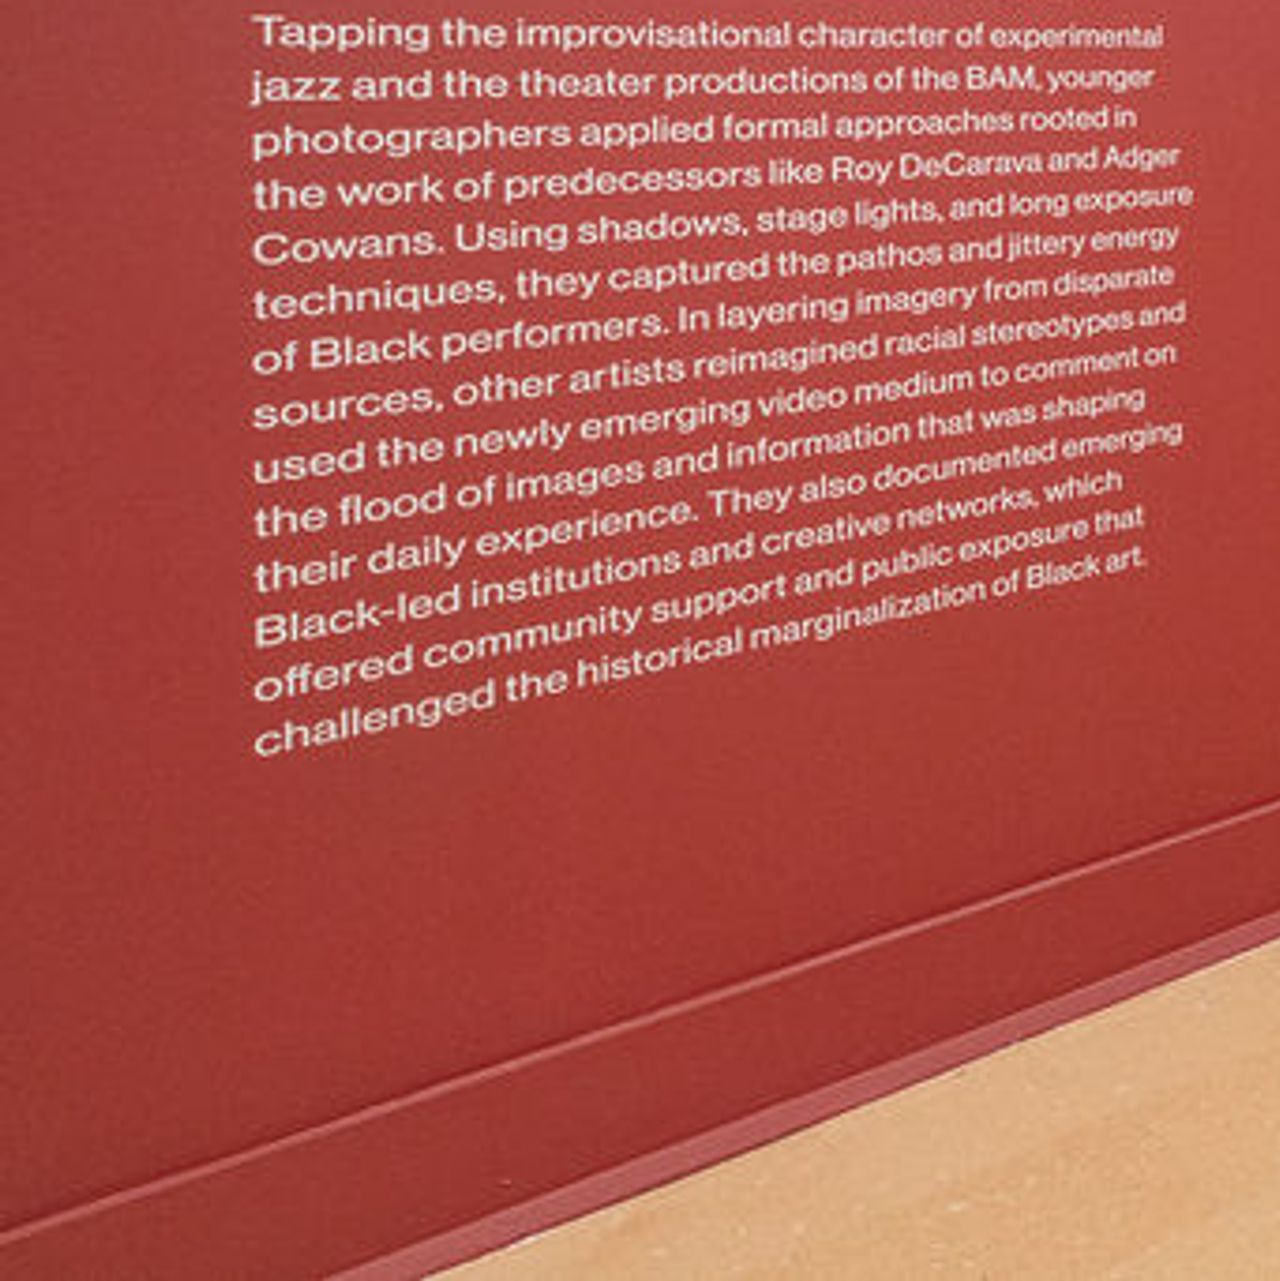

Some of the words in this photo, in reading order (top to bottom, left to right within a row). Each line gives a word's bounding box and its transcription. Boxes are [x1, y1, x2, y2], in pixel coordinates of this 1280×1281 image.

[248, 69, 342, 108] jazz
[350, 69, 433, 102] and
[441, 68, 510, 99] the
[518, 68, 658, 98] theater
[663, 65, 869, 101] productions
[873, 65, 906, 94] of
[911, 65, 961, 92] the
[964, 64, 1043, 92] BAM,
[1045, 68, 1156, 95] younger
[250, 13, 431, 54] Tapping
[440, 16, 508, 49] the
[515, 17, 792, 54] improvisational
[797, 20, 951, 50] character
[954, 21, 985, 49] of
[988, 23, 1164, 53] experimental
[251, 118, 573, 163] photographers
[578, 114, 715, 151] applied
[722, 110, 829, 142] formal
[834, 107, 1015, 142] approaches
[1019, 104, 1110, 132] rooted
[1113, 104, 1138, 129] in
[252, 178, 328, 212] the
[335, 172, 445, 208] work
[453, 169, 496, 203] of
[503, 164, 763, 206] predecessors
[768, 157, 825, 186] like
[830, 155, 894, 187] Roy
[899, 149, 1044, 180] DeCarava
[1046, 145, 1100, 173] and
[1102, 144, 1182, 173] Adger
[251, 230, 445, 267] Cowans.
[454, 219, 570, 253] Using
[576, 211, 750, 246] shadows,
[755, 205, 849, 237] stage
[854, 197, 946, 232] lights,
[948, 192, 1005, 222] and
[1008, 191, 1070, 219] long
[1072, 185, 1195, 215] exposure
[252, 278, 507, 321] techniques,
[515, 268, 602, 301] they
[606, 251, 771, 293] captured
[775, 249, 831, 278] the
[835, 242, 943, 278] pathos
[948, 233, 1004, 264] and
[1006, 232, 1087, 263] jittery
[1089, 225, 1180, 252] energy
[251, 339, 299, 376] of
[309, 328, 433, 371] Black
[441, 313, 671, 364] performers.
[678, 305, 711, 333] In
[717, 293, 850, 333] layering
[855, 285, 979, 316] imagery
[982, 276, 1049, 303] from
[1052, 264, 1176, 297] disparate
[251, 386, 445, 431] sources,
[451, 372, 563, 407] other
[568, 356, 687, 394] artists
[692, 332, 879, 379] reimagined
[884, 322, 967, 357] racial
[970, 310, 1136, 347] stereotypes
[1138, 299, 1187, 327] and
[252, 440, 366, 485] used
[375, 436, 445, 469] the
[453, 417, 573, 458] newly
[579, 397, 752, 442] emerging
[756, 385, 849, 418] video
[853, 369, 975, 406] medium
[979, 364, 1010, 389] to
[1013, 345, 1140, 384] comment
[1143, 343, 1177, 368] on
[253, 504, 329, 539] the
[337, 481, 448, 527] flood
[454, 474, 498, 509] of
[505, 459, 646, 502] images
[651, 442, 720, 481] and
[726, 421, 912, 470] information
[917, 407, 975, 441] that
[978, 403, 1038, 431] was
[1041, 388, 1146, 422] shaping
[252, 549, 359, 594] their
[366, 533, 468, 575] daily
[474, 500, 700, 557] experience.
[705, 484, 795, 518] They
[798, 472, 868, 504] also
[871, 437, 1058, 492] documented
[1061, 422, 1184, 460] emerging
[254, 582, 462, 650] Black-led
[470, 549, 683, 609] institutions
[688, 531, 756, 571] and
[760, 512, 892, 556] creative
[896, 485, 1040, 531] networks,
[1042, 468, 1123, 503] which
[253, 642, 415, 703] offered
[422, 605, 644, 669] community
[650, 573, 787, 624] support
[793, 558, 856, 597] and
[861, 542, 954, 588] public
[957, 519, 1090, 563] exposure
[1094, 503, 1145, 536] that
[253, 677, 496, 758] challenged
[505, 669, 569, 703] the
[576, 625, 744, 688] historical
[749, 580, 988, 650] marginalization
[990, 568, 1021, 598] of
[1025, 553, 1101, 591] Black
[1104, 545, 1147, 574] art.
